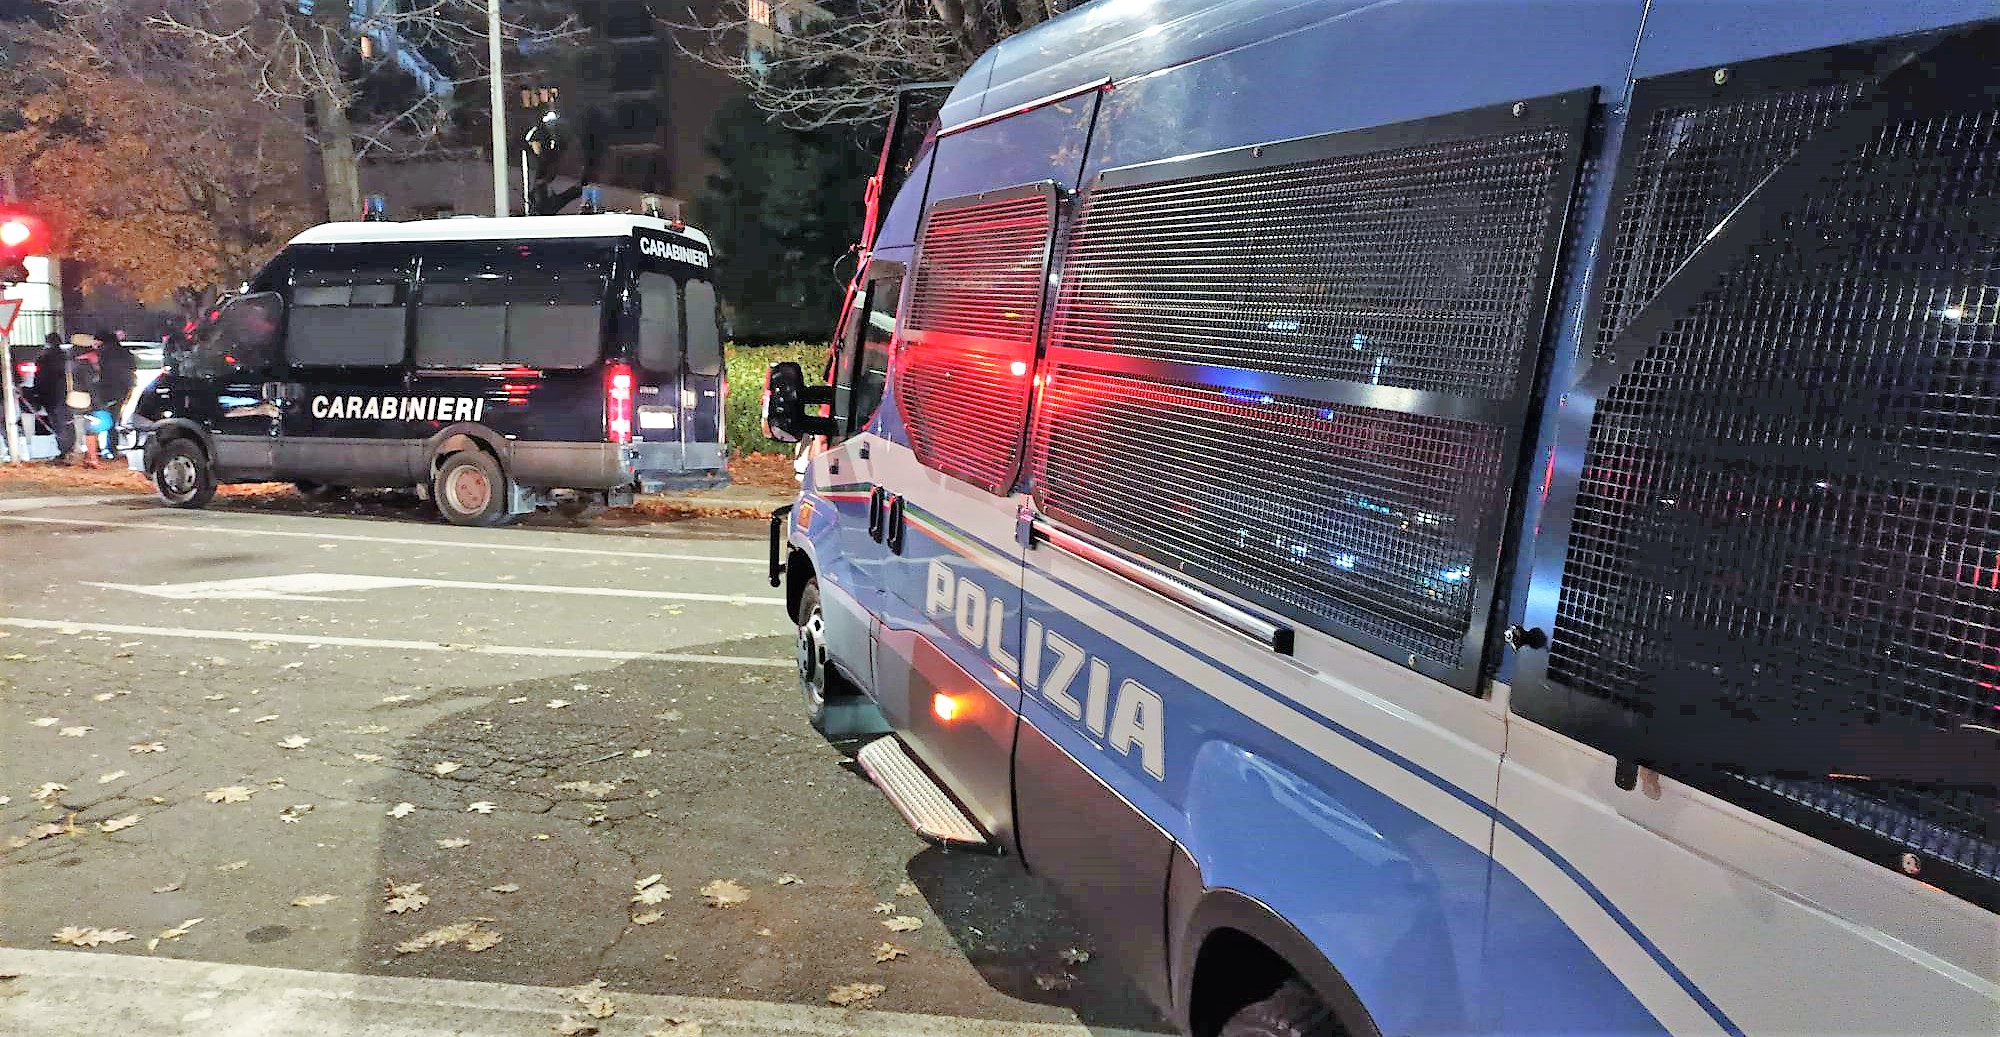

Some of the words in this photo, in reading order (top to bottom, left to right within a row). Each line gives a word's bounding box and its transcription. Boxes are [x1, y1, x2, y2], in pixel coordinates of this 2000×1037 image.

[639, 236, 709, 269] CARABINIERI
[311, 395, 484, 422] CARABINIERI
[926, 557, 1166, 783] POLIZIA
